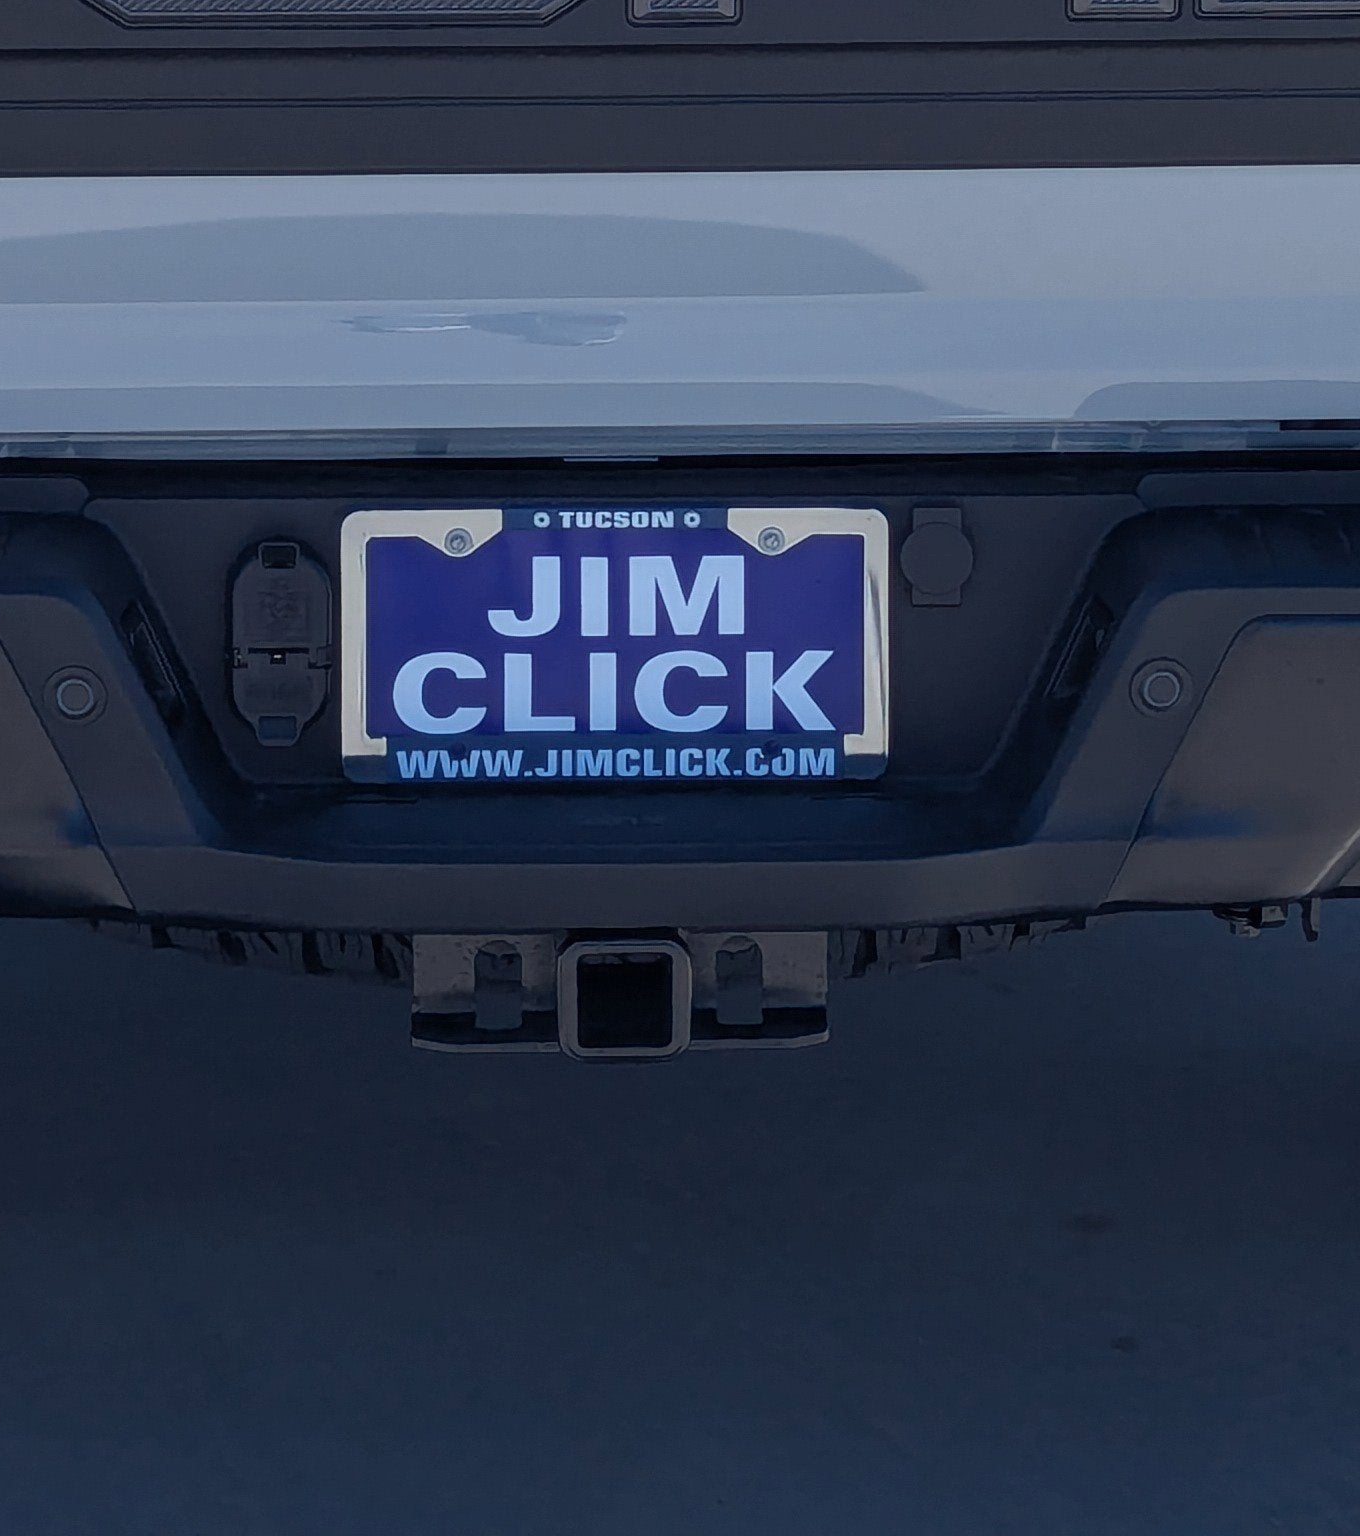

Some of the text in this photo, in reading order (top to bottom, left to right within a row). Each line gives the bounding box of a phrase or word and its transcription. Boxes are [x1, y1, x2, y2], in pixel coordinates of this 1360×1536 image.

[557, 510, 675, 529] TUCSON
[487, 555, 745, 637] JIM
[392, 650, 836, 734] CLICK
[396, 747, 836, 779] WWW.JIMCLICK.COM
